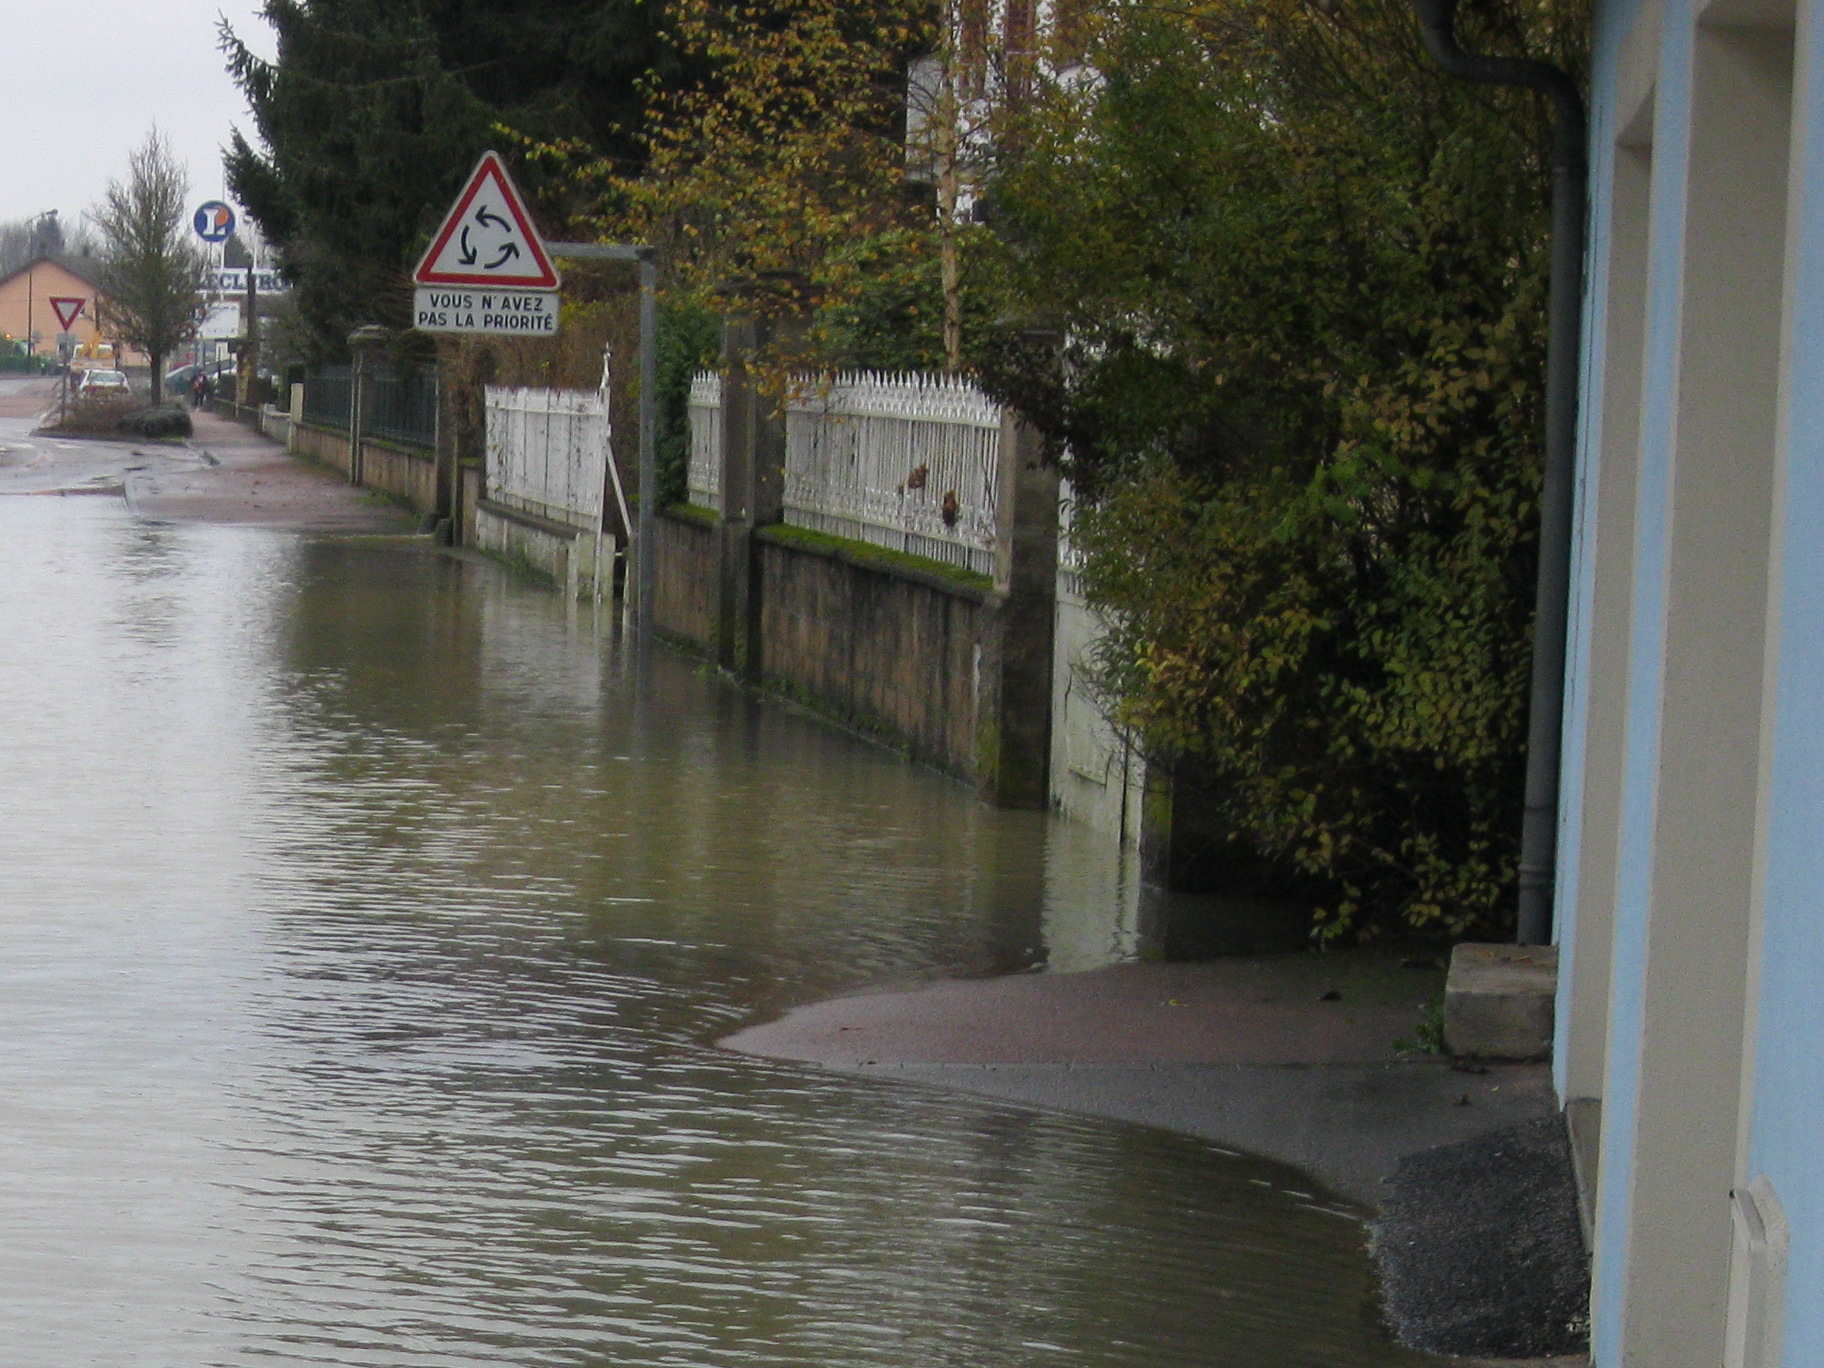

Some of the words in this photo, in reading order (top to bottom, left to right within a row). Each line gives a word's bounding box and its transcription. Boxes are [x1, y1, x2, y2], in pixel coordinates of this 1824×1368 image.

[430, 293, 473, 309] VOUS
[418, 311, 447, 326] PAS
[456, 313, 475, 327] LA
[483, 313, 553, 330] PRIORITÉ
